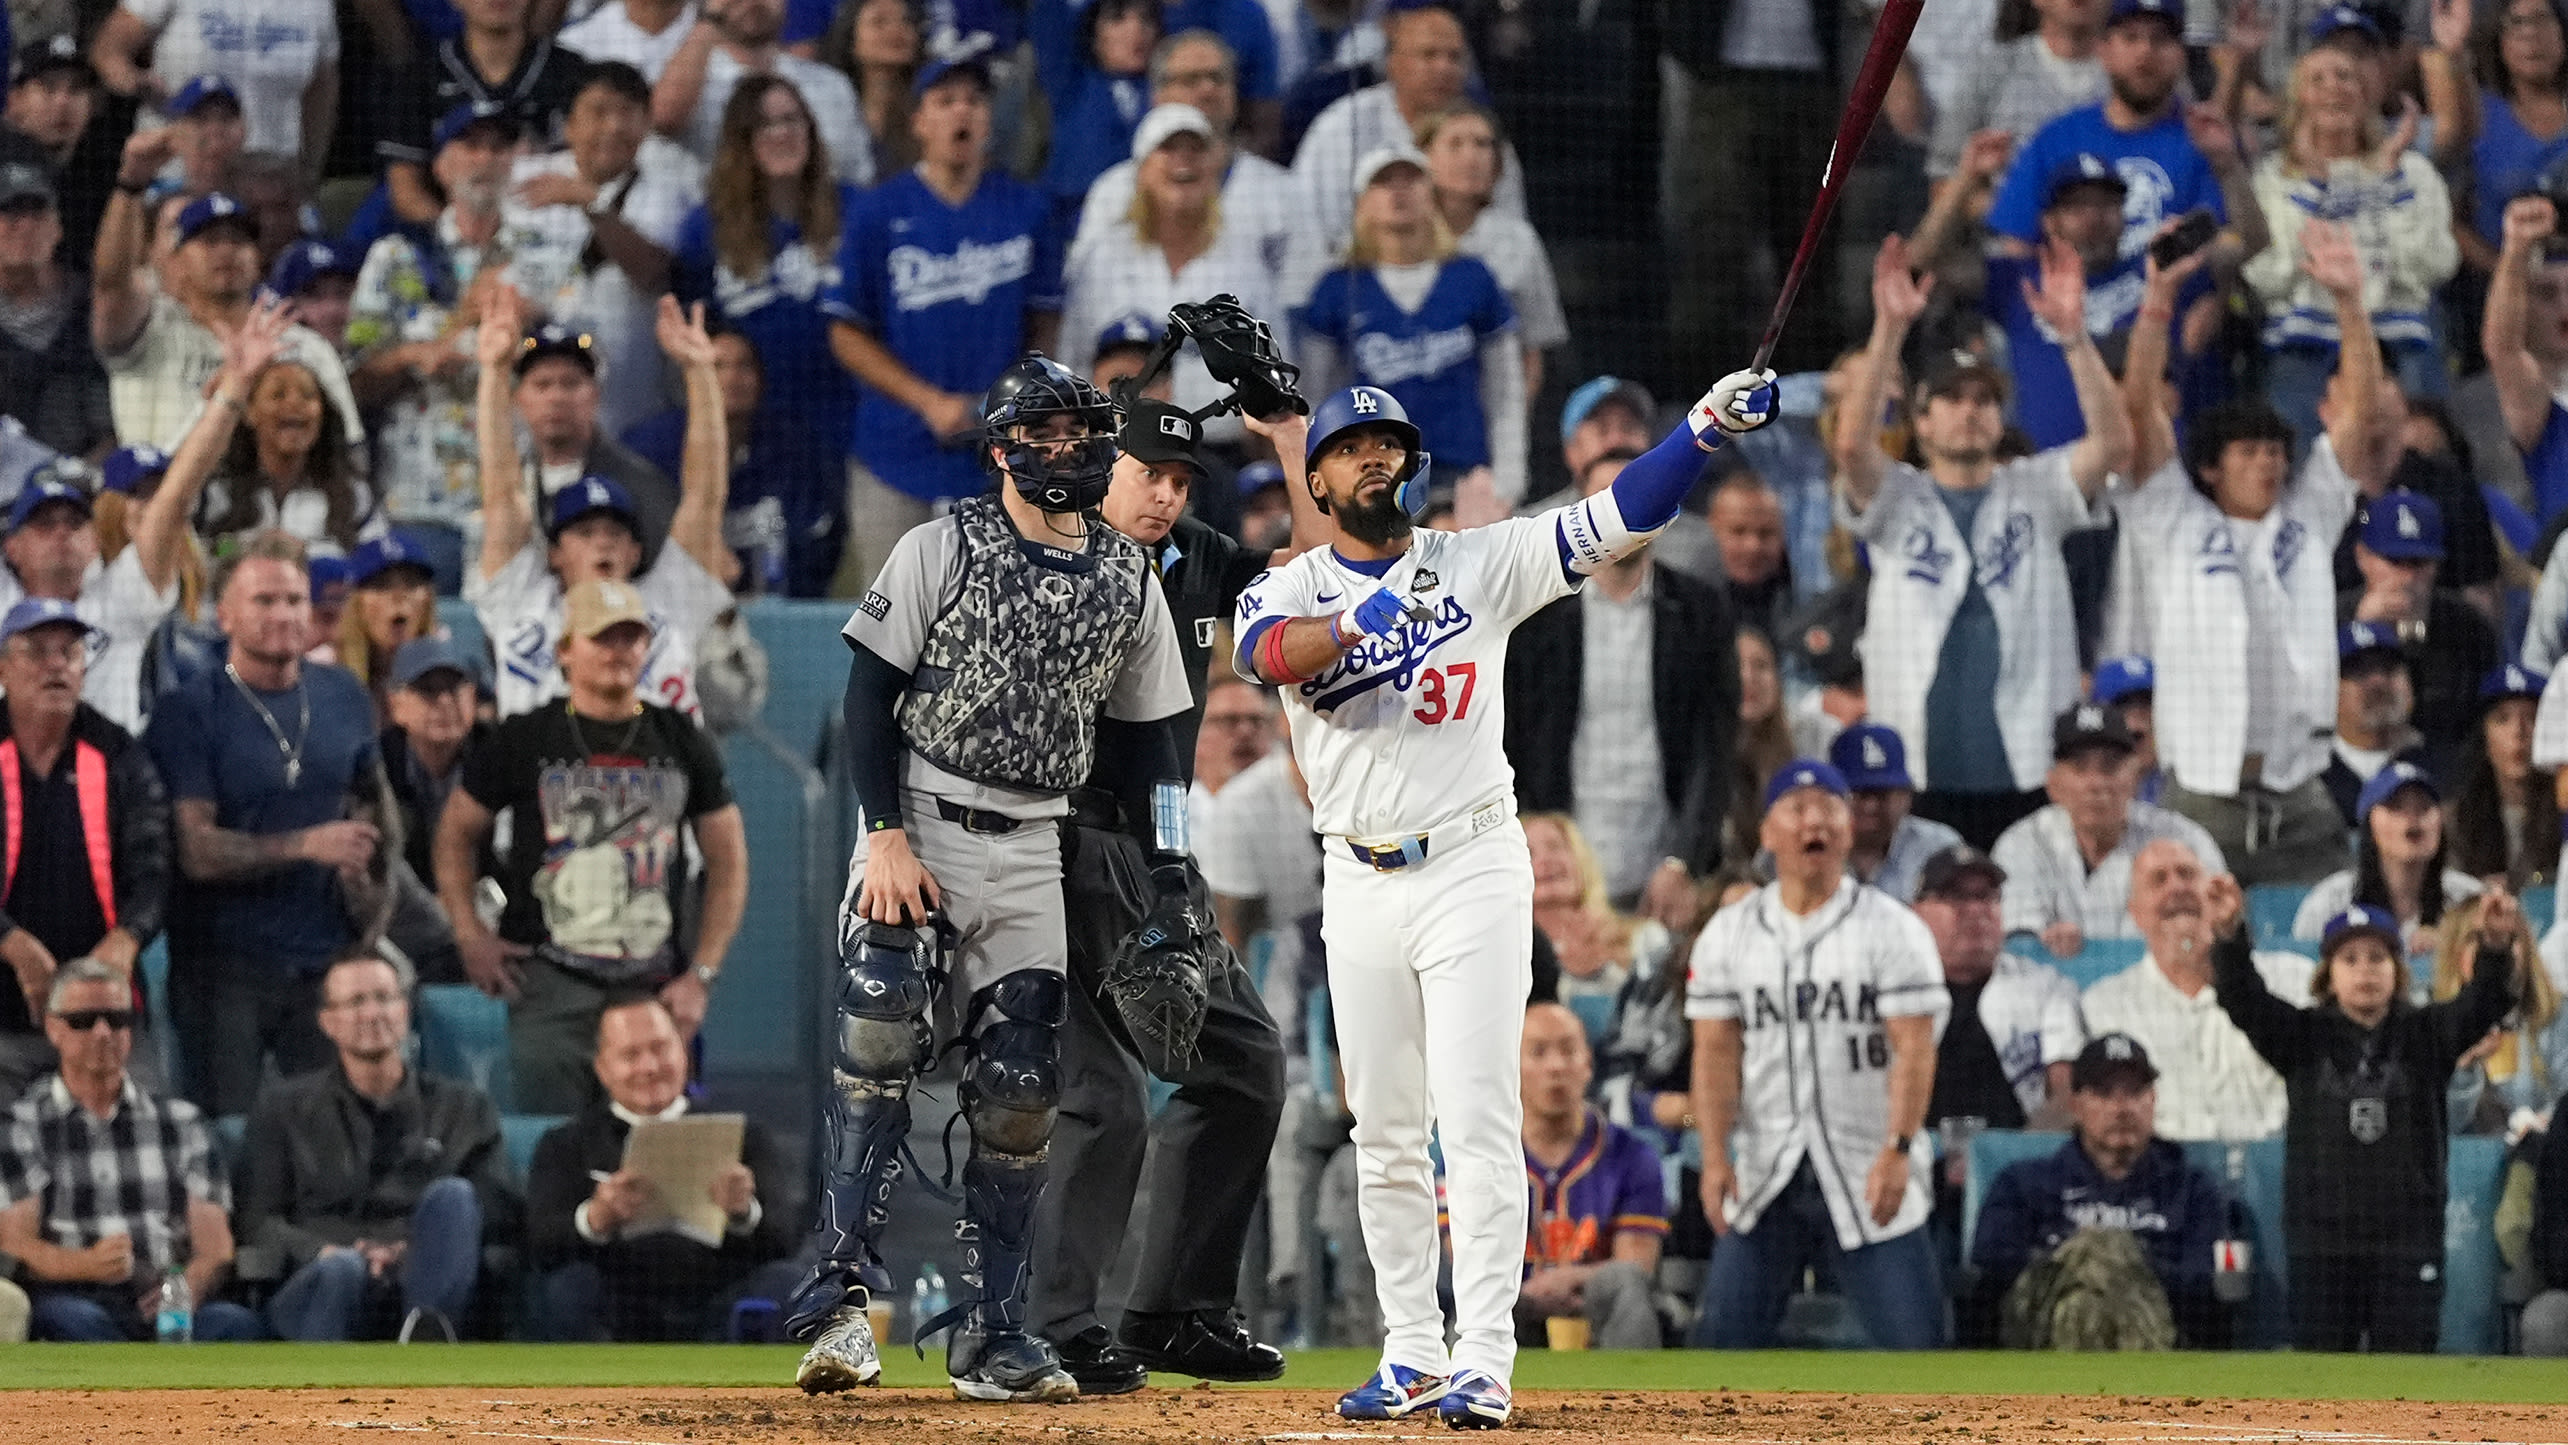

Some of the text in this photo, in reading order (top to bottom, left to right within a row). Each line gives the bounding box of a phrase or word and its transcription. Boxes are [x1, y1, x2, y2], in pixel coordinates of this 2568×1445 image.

[1350, 387, 1378, 414] LA
[1043, 548, 1073, 561] WELLS
[1238, 592, 1263, 624] LA
[1413, 661, 1477, 726] 37
[1848, 1032, 1888, 1072] 16
